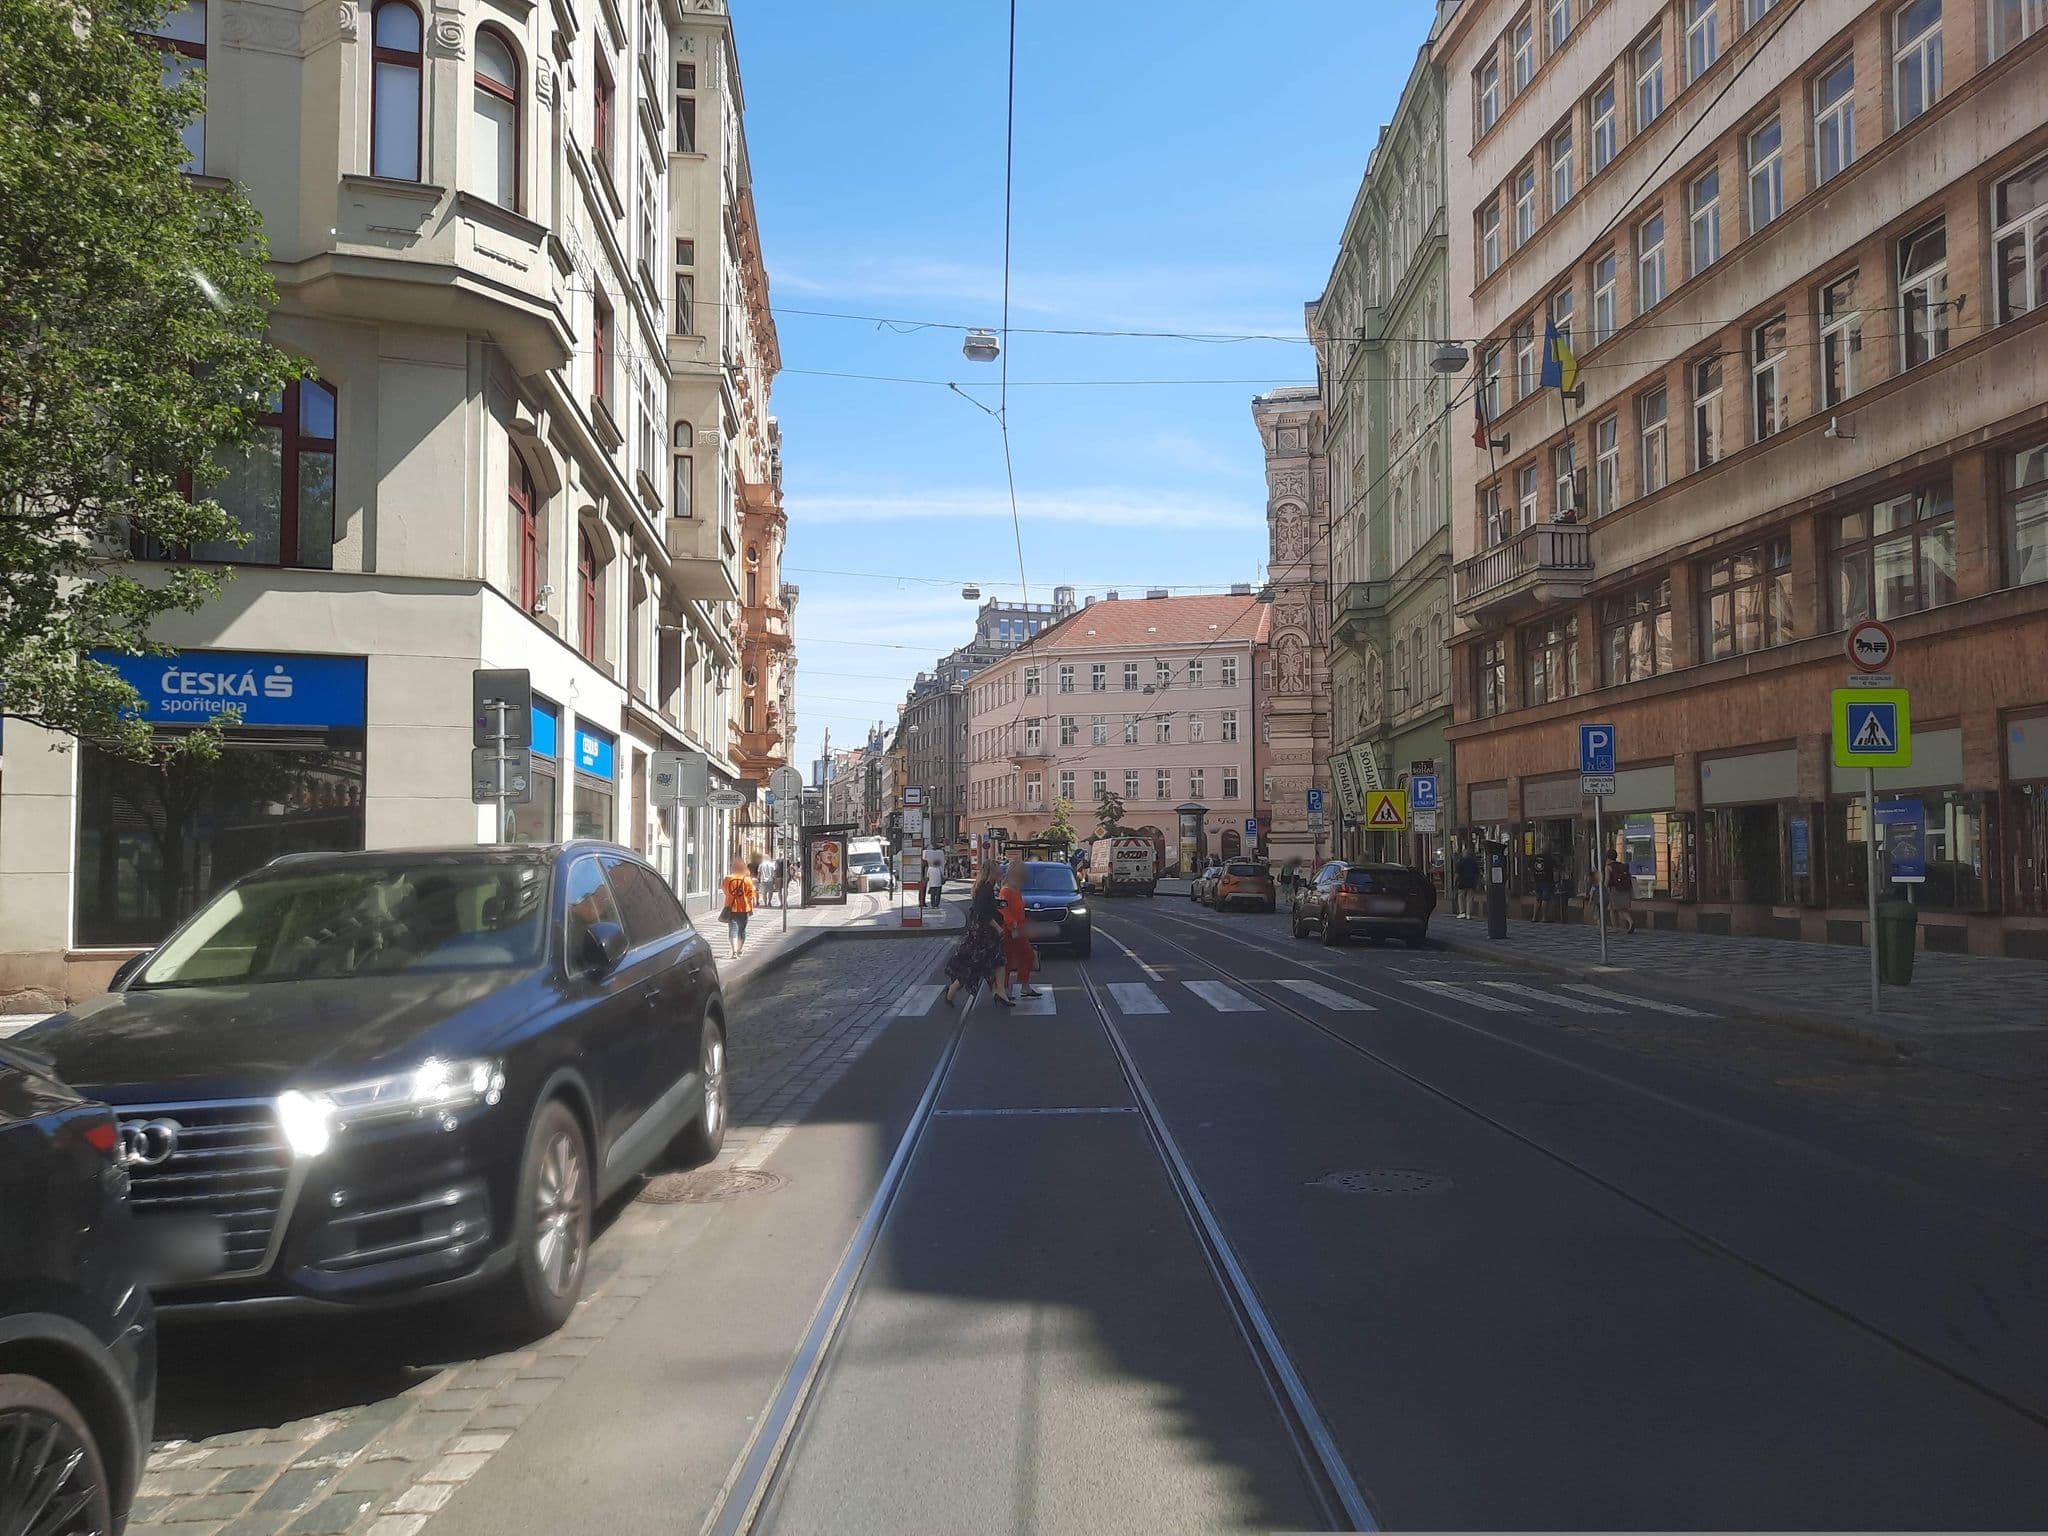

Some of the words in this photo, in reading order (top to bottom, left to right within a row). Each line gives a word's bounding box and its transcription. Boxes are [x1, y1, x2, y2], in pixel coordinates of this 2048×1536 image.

[161, 665, 258, 697] ČESKÁ
[161, 697, 248, 714] spořitelna
[1588, 730, 1609, 758] P
[1360, 750, 1379, 790] ŠOHAJK
[1310, 791, 1319, 804] P
[1418, 780, 1432, 799] P
[1247, 820, 1256, 830] P
[1492, 854, 1499, 863] P
